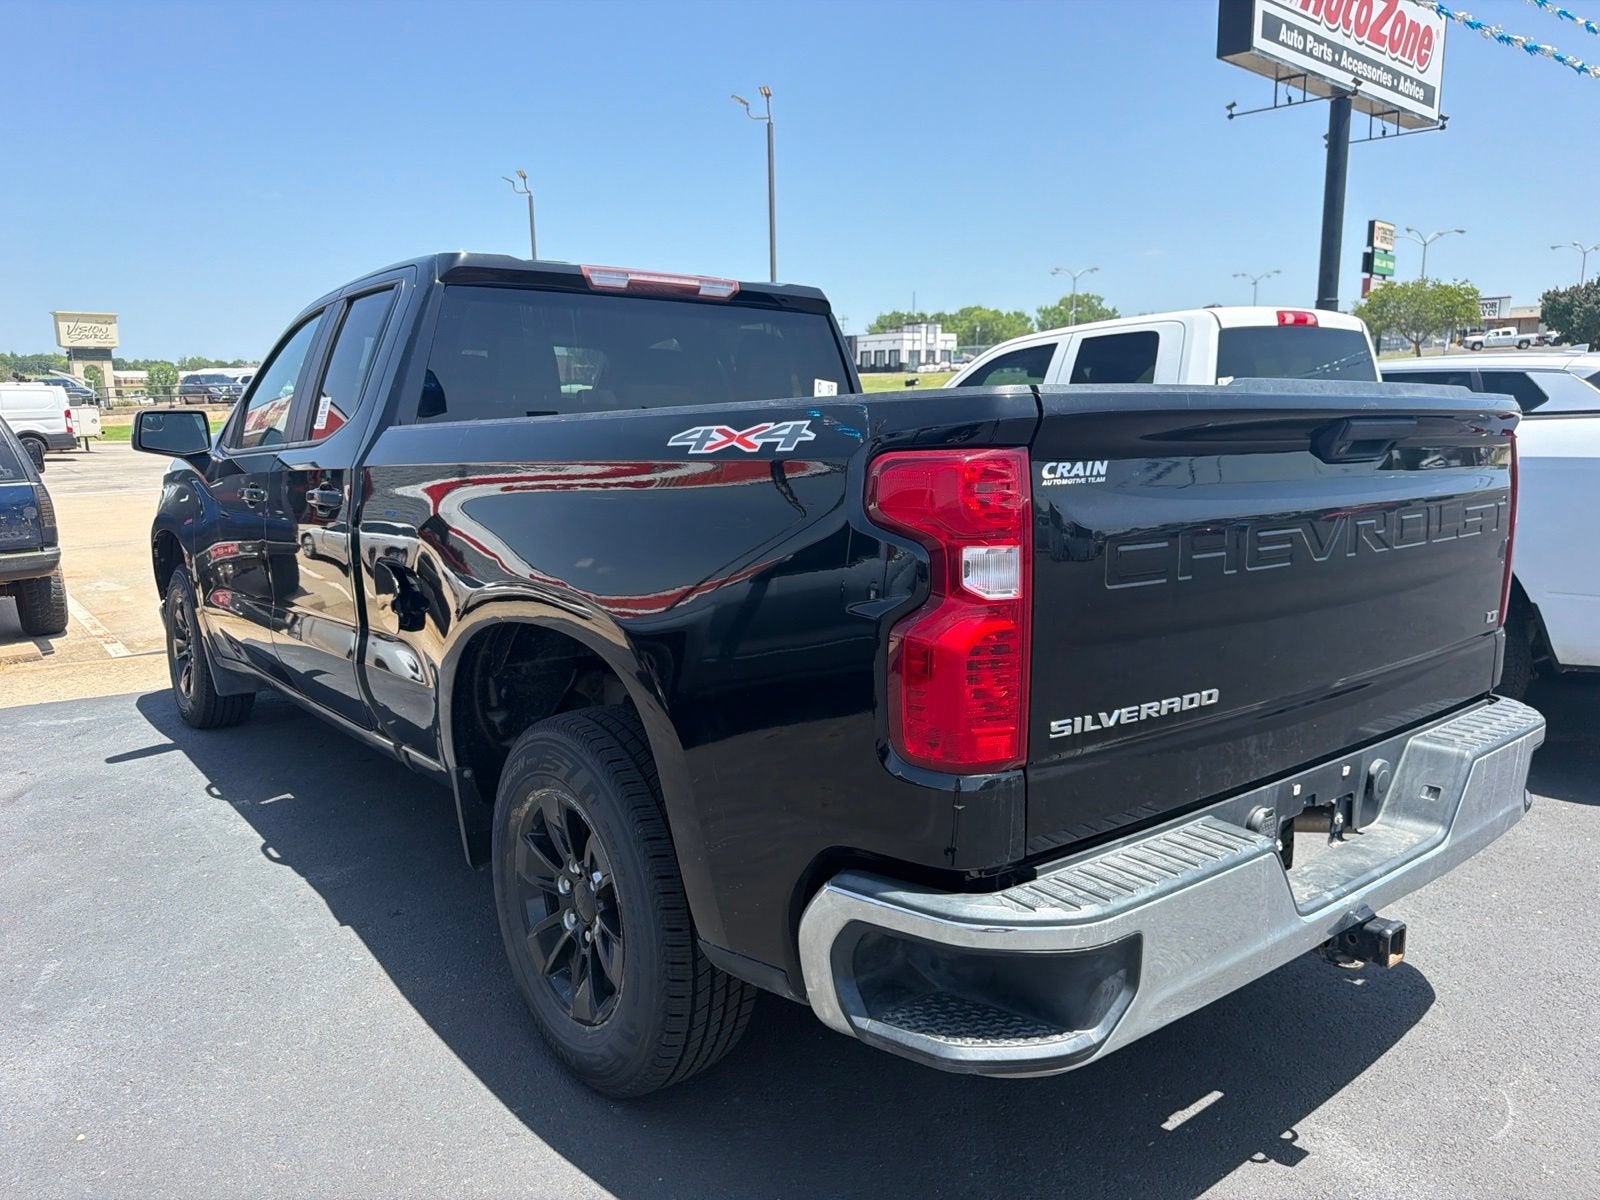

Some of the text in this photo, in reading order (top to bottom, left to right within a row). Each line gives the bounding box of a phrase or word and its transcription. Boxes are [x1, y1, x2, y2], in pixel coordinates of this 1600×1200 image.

[1278, 23, 1425, 101] Auto Parts Accessories Advice
[1041, 460, 1109, 479] CRAIN
[1042, 478, 1086, 486] AUTOMOTIVE
[1104, 495, 1508, 589] CHEVROLET
[1049, 688, 1220, 739] SILVERADO
